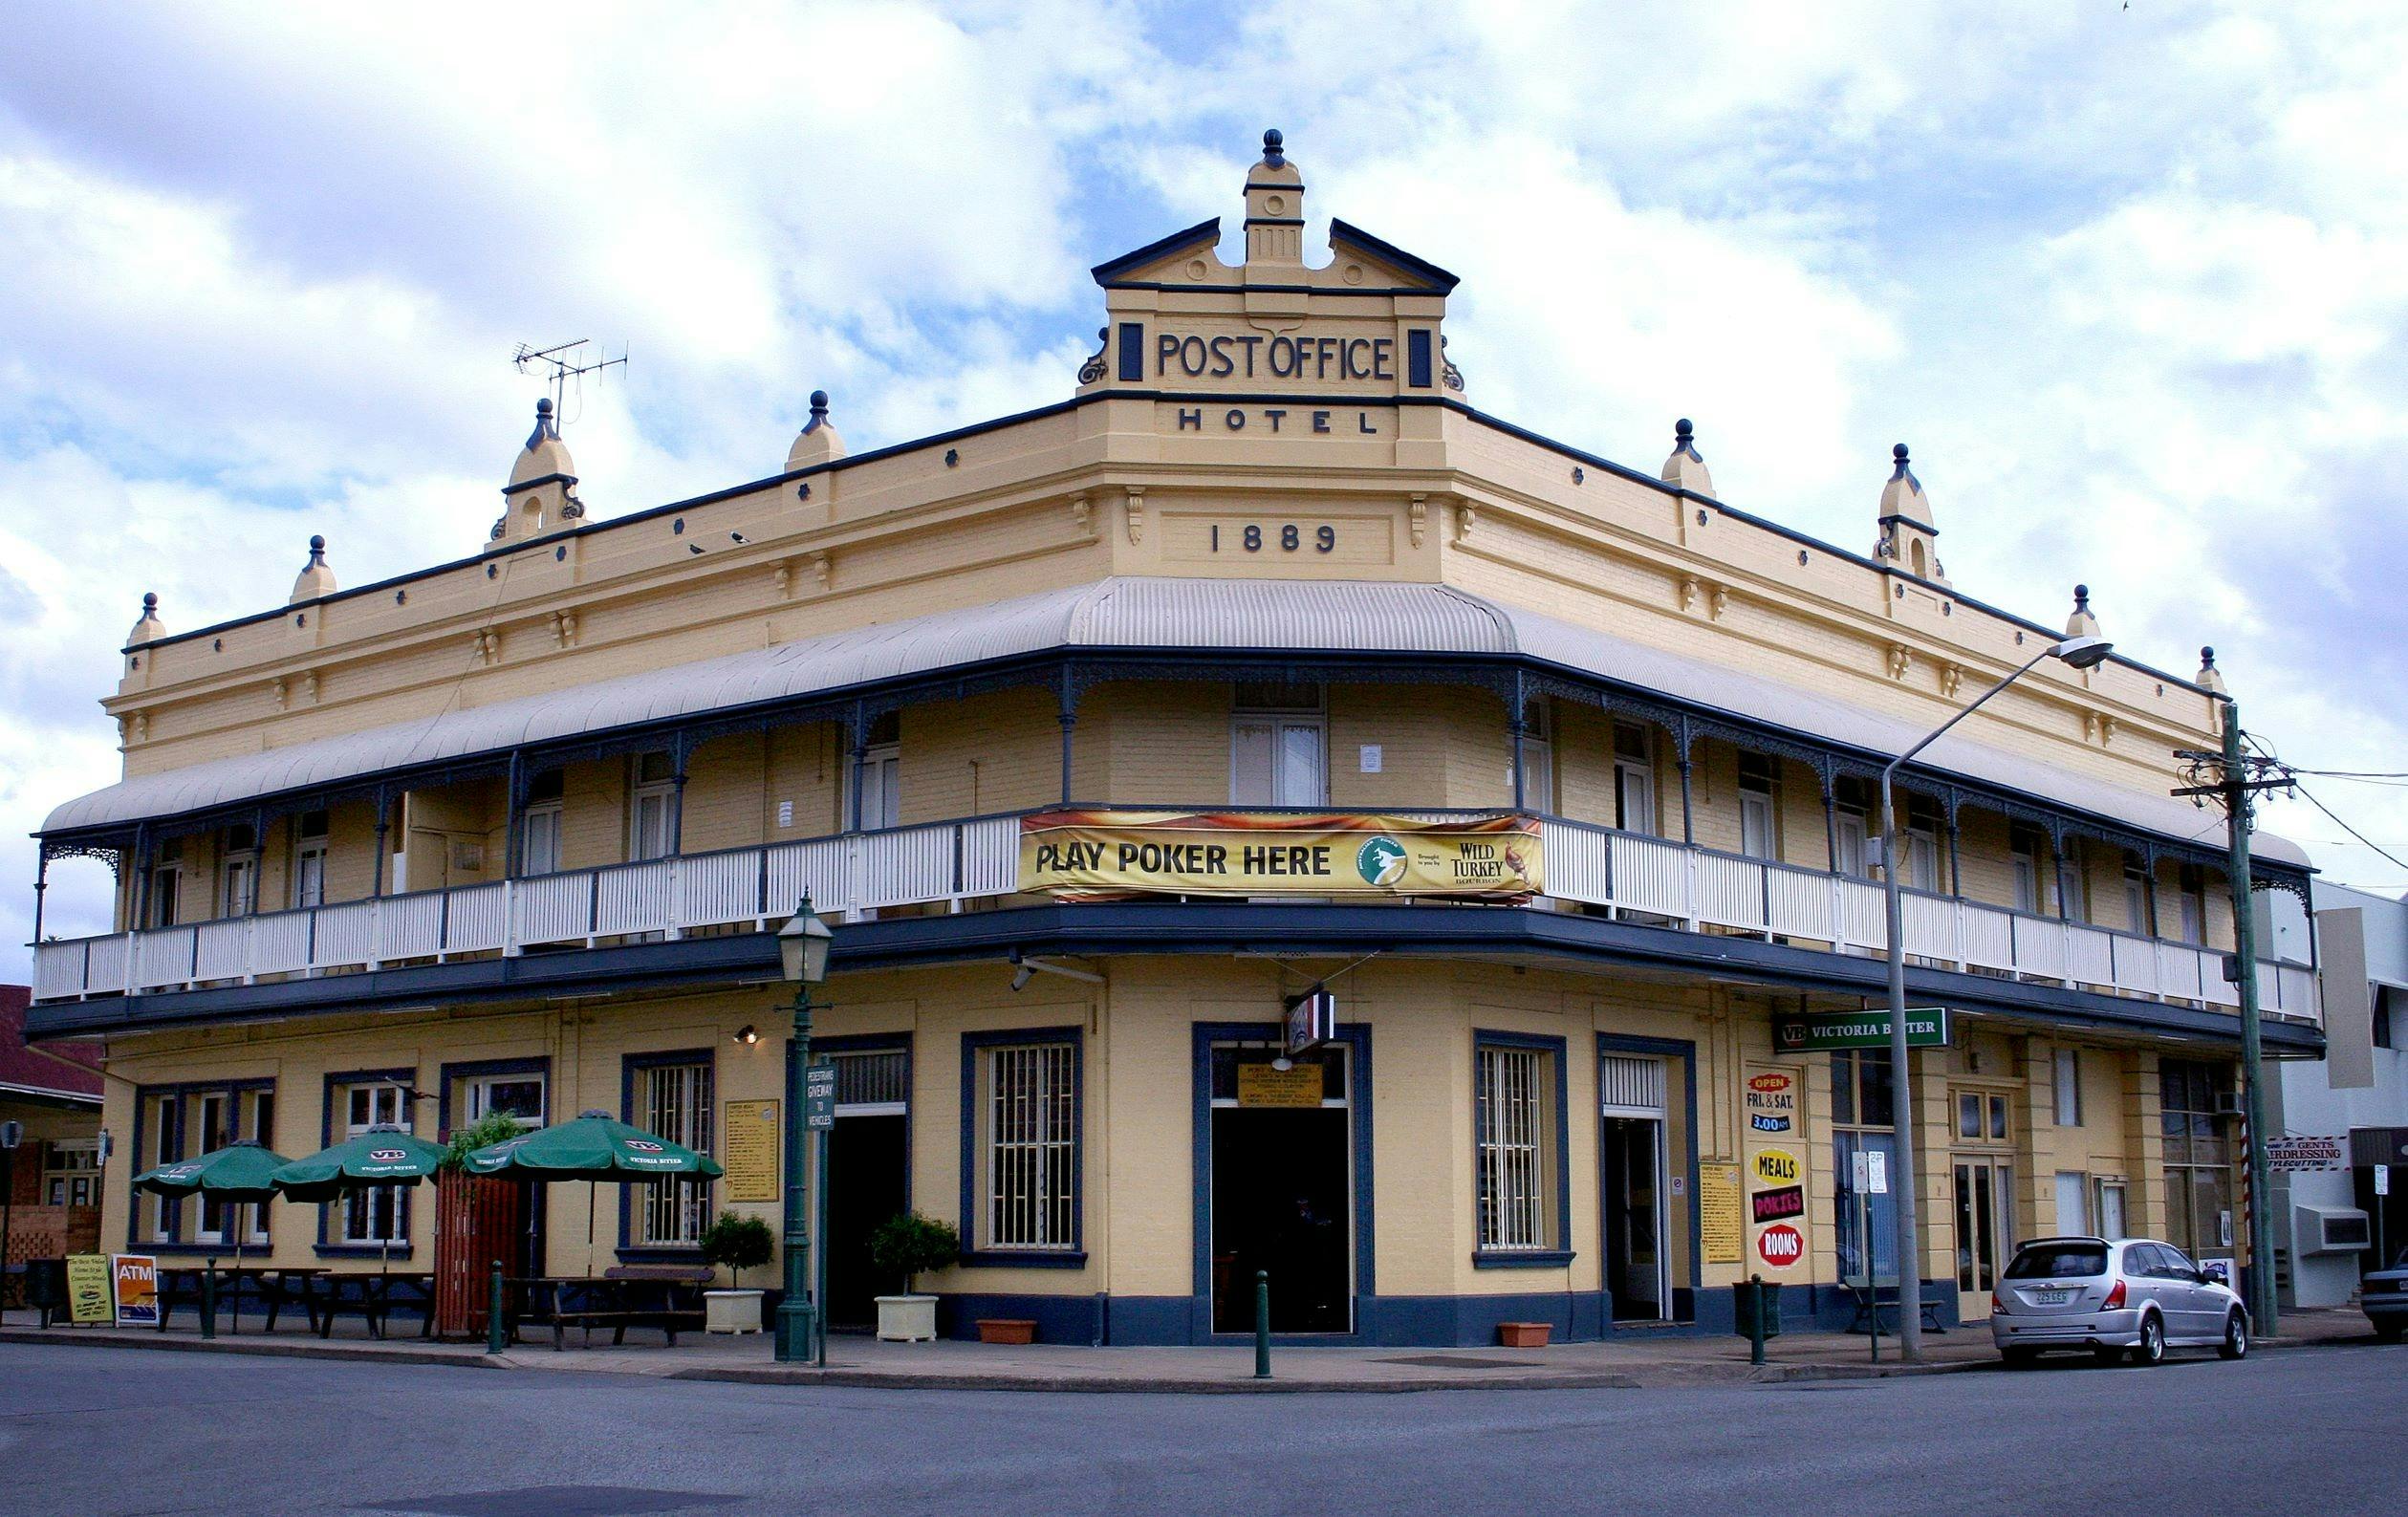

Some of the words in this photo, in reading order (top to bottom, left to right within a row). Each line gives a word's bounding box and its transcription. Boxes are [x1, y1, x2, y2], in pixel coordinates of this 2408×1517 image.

[1159, 335, 1264, 378] POST
[1269, 336, 1394, 380] OFFICE
[1179, 408, 1378, 434] HOTEL
[1212, 525, 1335, 553] 1889
[1035, 842, 1106, 873] PLAY
[1118, 843, 1226, 874] POKER
[1243, 845, 1332, 876] HERE
[1460, 842, 1494, 859] WILD
[1451, 858, 1503, 877] TURKEY
[1811, 1024, 1877, 1038] VICTORIA
[1882, 1021, 1936, 1034] BTER
[1755, 1078, 1784, 1088] OPEN
[816, 1101, 823, 1111] TO
[1746, 1093, 1765, 1108] FRI.
[1766, 1094, 1773, 1108] &
[1774, 1094, 1793, 1109] SAT.
[809, 1116, 832, 1126] VEHICLES
[1759, 1156, 1795, 1180] MEALS
[1755, 1192, 1801, 1217] POKIES
[1765, 1232, 1797, 1256] ROOMS
[119, 1265, 153, 1281] ATM
